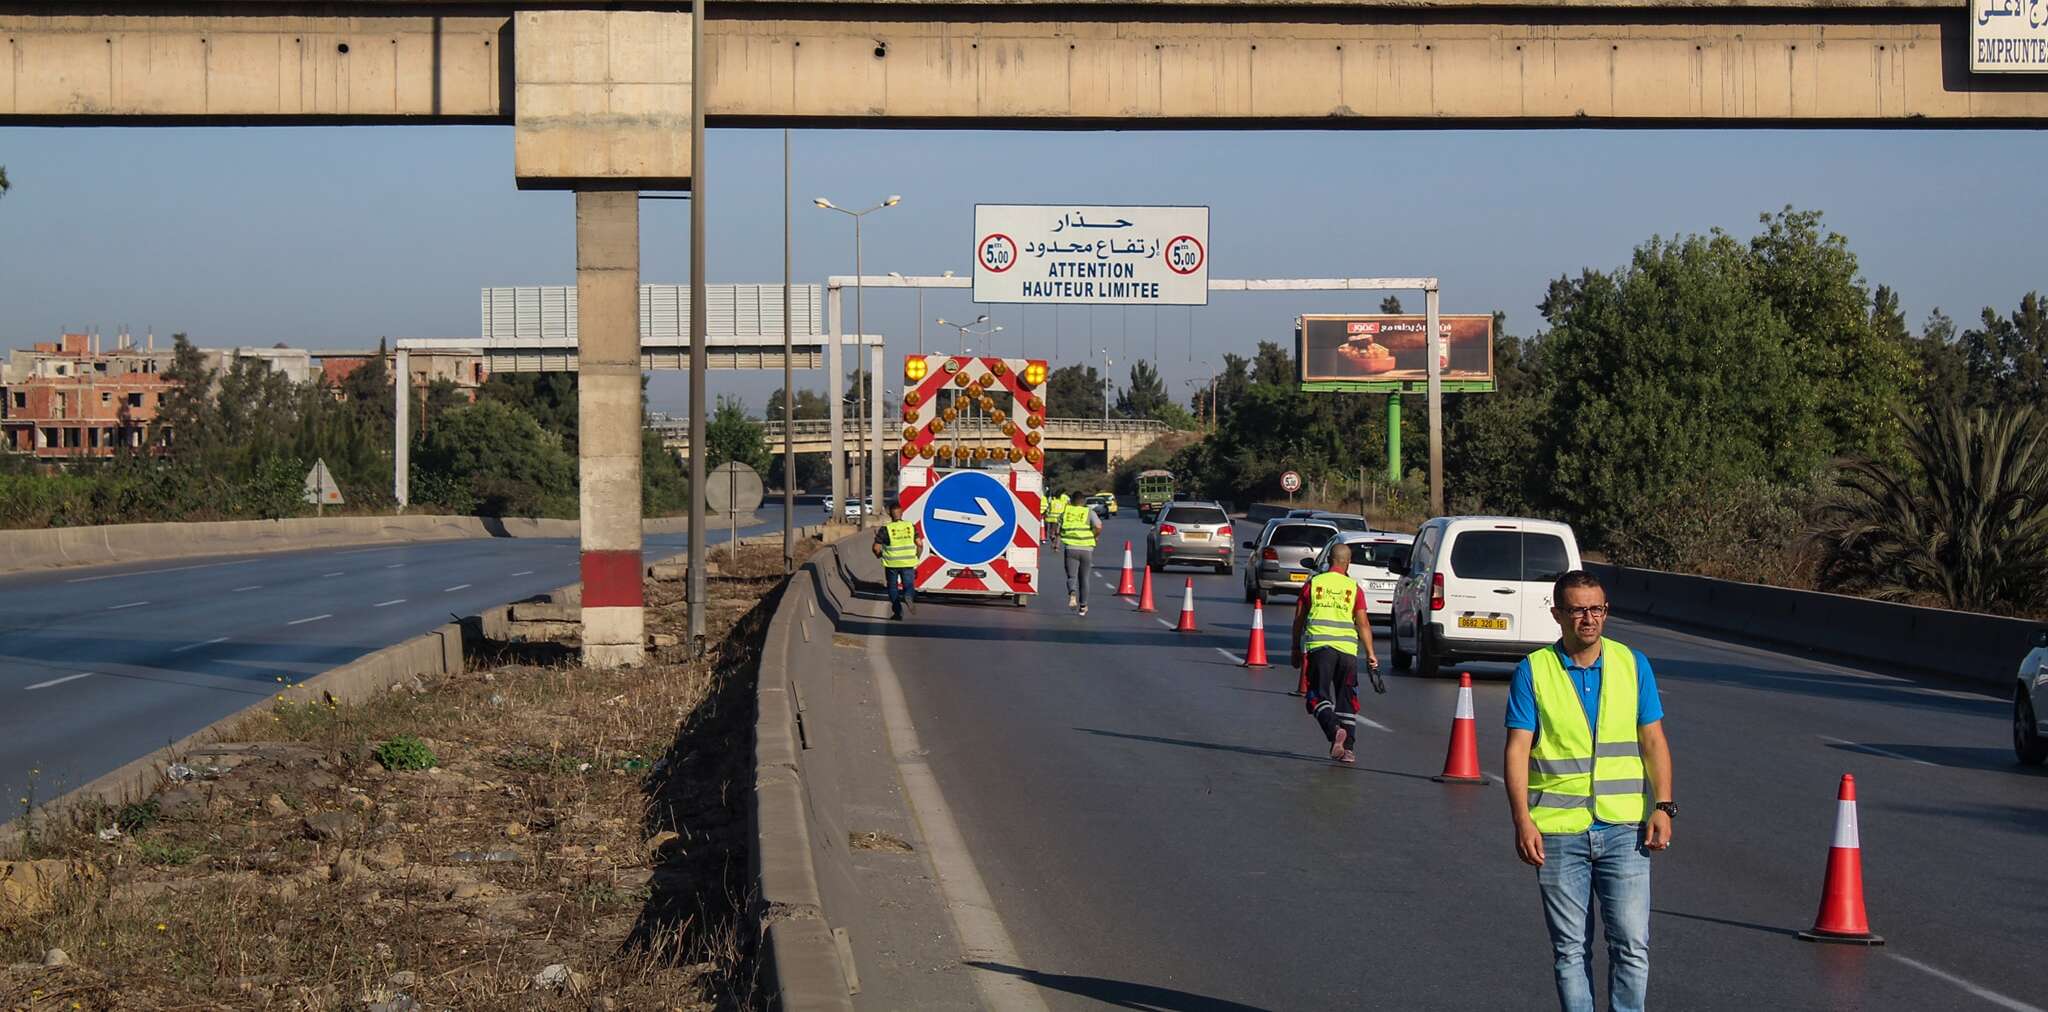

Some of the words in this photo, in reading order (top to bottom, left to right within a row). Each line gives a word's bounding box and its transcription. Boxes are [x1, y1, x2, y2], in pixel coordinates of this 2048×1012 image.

[1978, 38, 2048, 64] EMPRUNTE
[1048, 211, 1133, 232] حذار
[986, 244, 1009, 264] 5.00
[1025, 241, 1093, 258] محدود
[1173, 246, 1196, 266] 5.00
[1048, 262, 1134, 278] ATTENTION
[1023, 281, 1094, 297] HAUTEUR
[1099, 282, 1159, 298] LIMITEE
